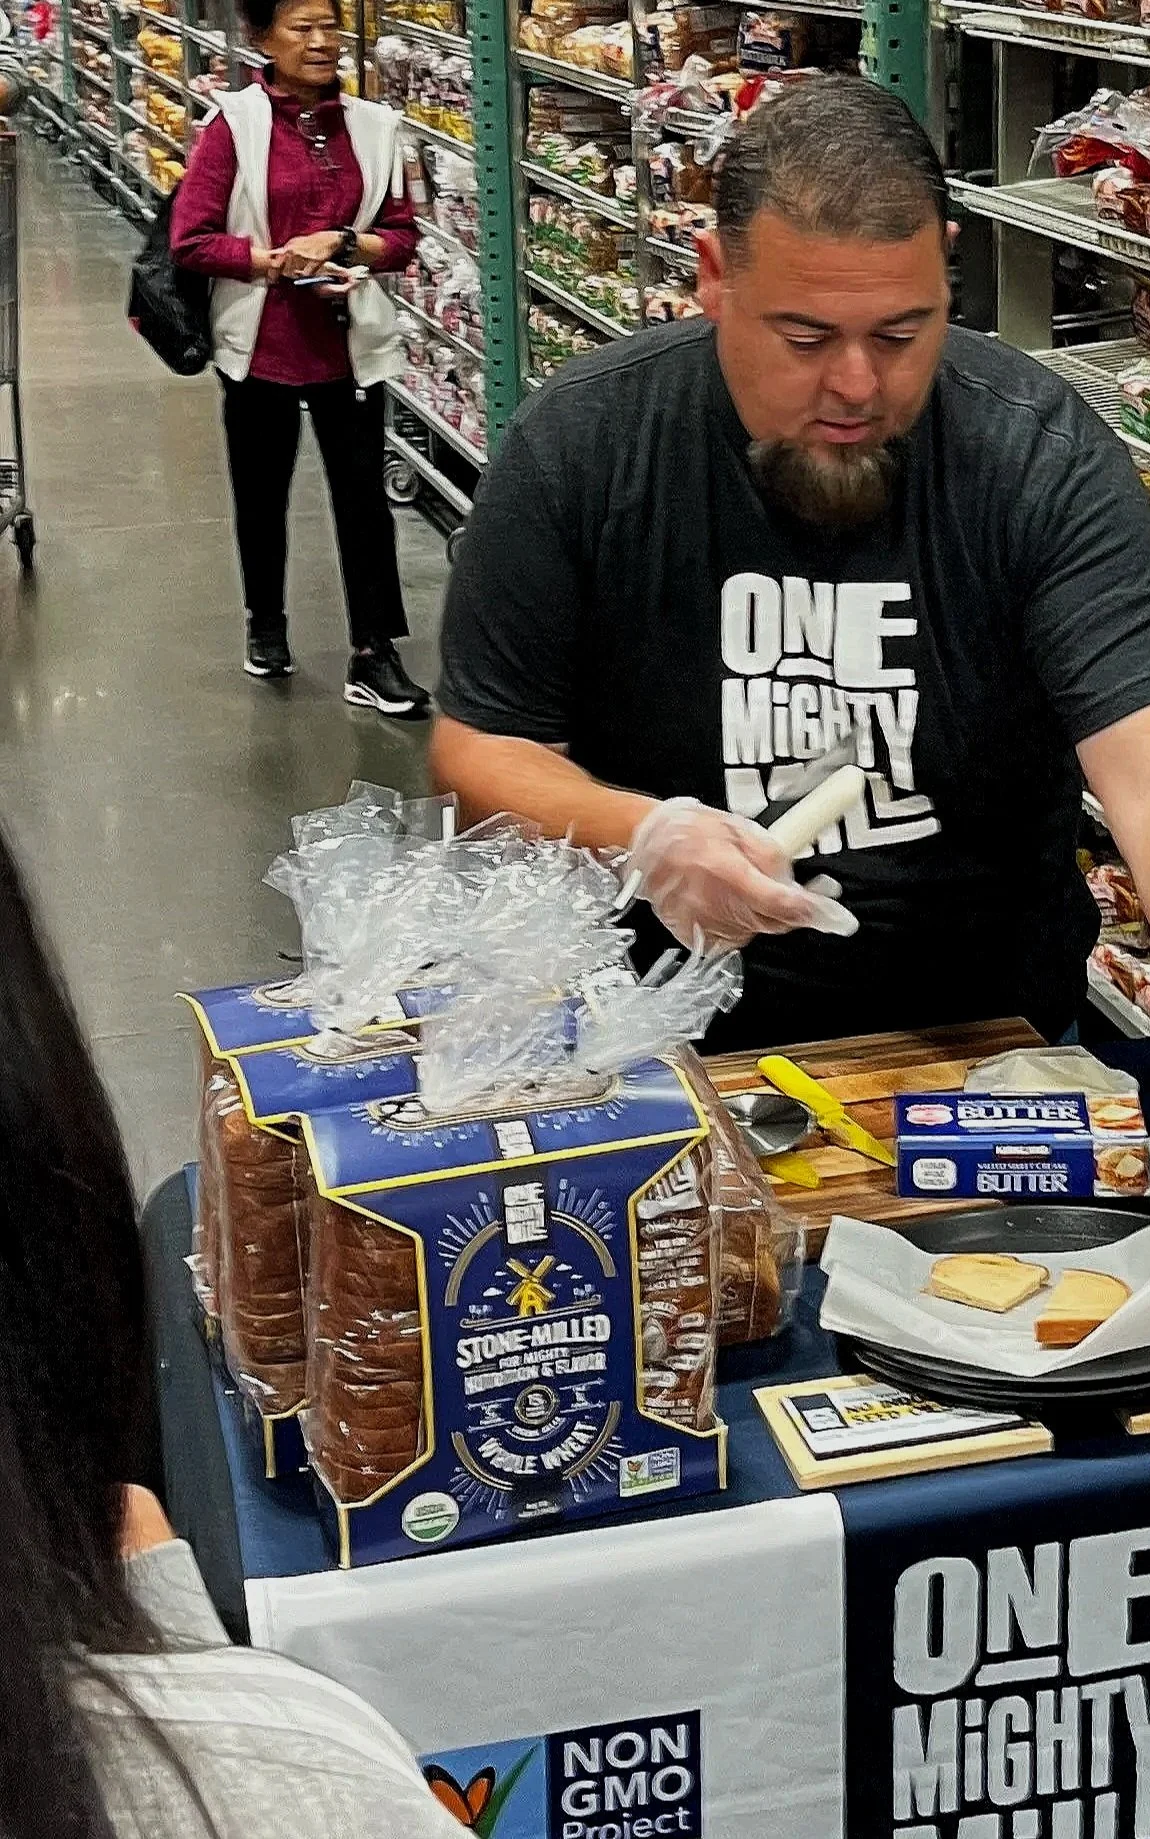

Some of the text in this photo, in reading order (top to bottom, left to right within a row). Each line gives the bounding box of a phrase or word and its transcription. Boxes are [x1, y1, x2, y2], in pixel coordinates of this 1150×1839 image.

[721, 572, 918, 688] ONE
[957, 1106, 1080, 1120] BUTTER
[976, 1173, 1069, 1193] BUTTER
[564, 1724, 690, 1778] NON
[561, 1765, 693, 1818] GMO
[562, 1806, 693, 1839] Project
